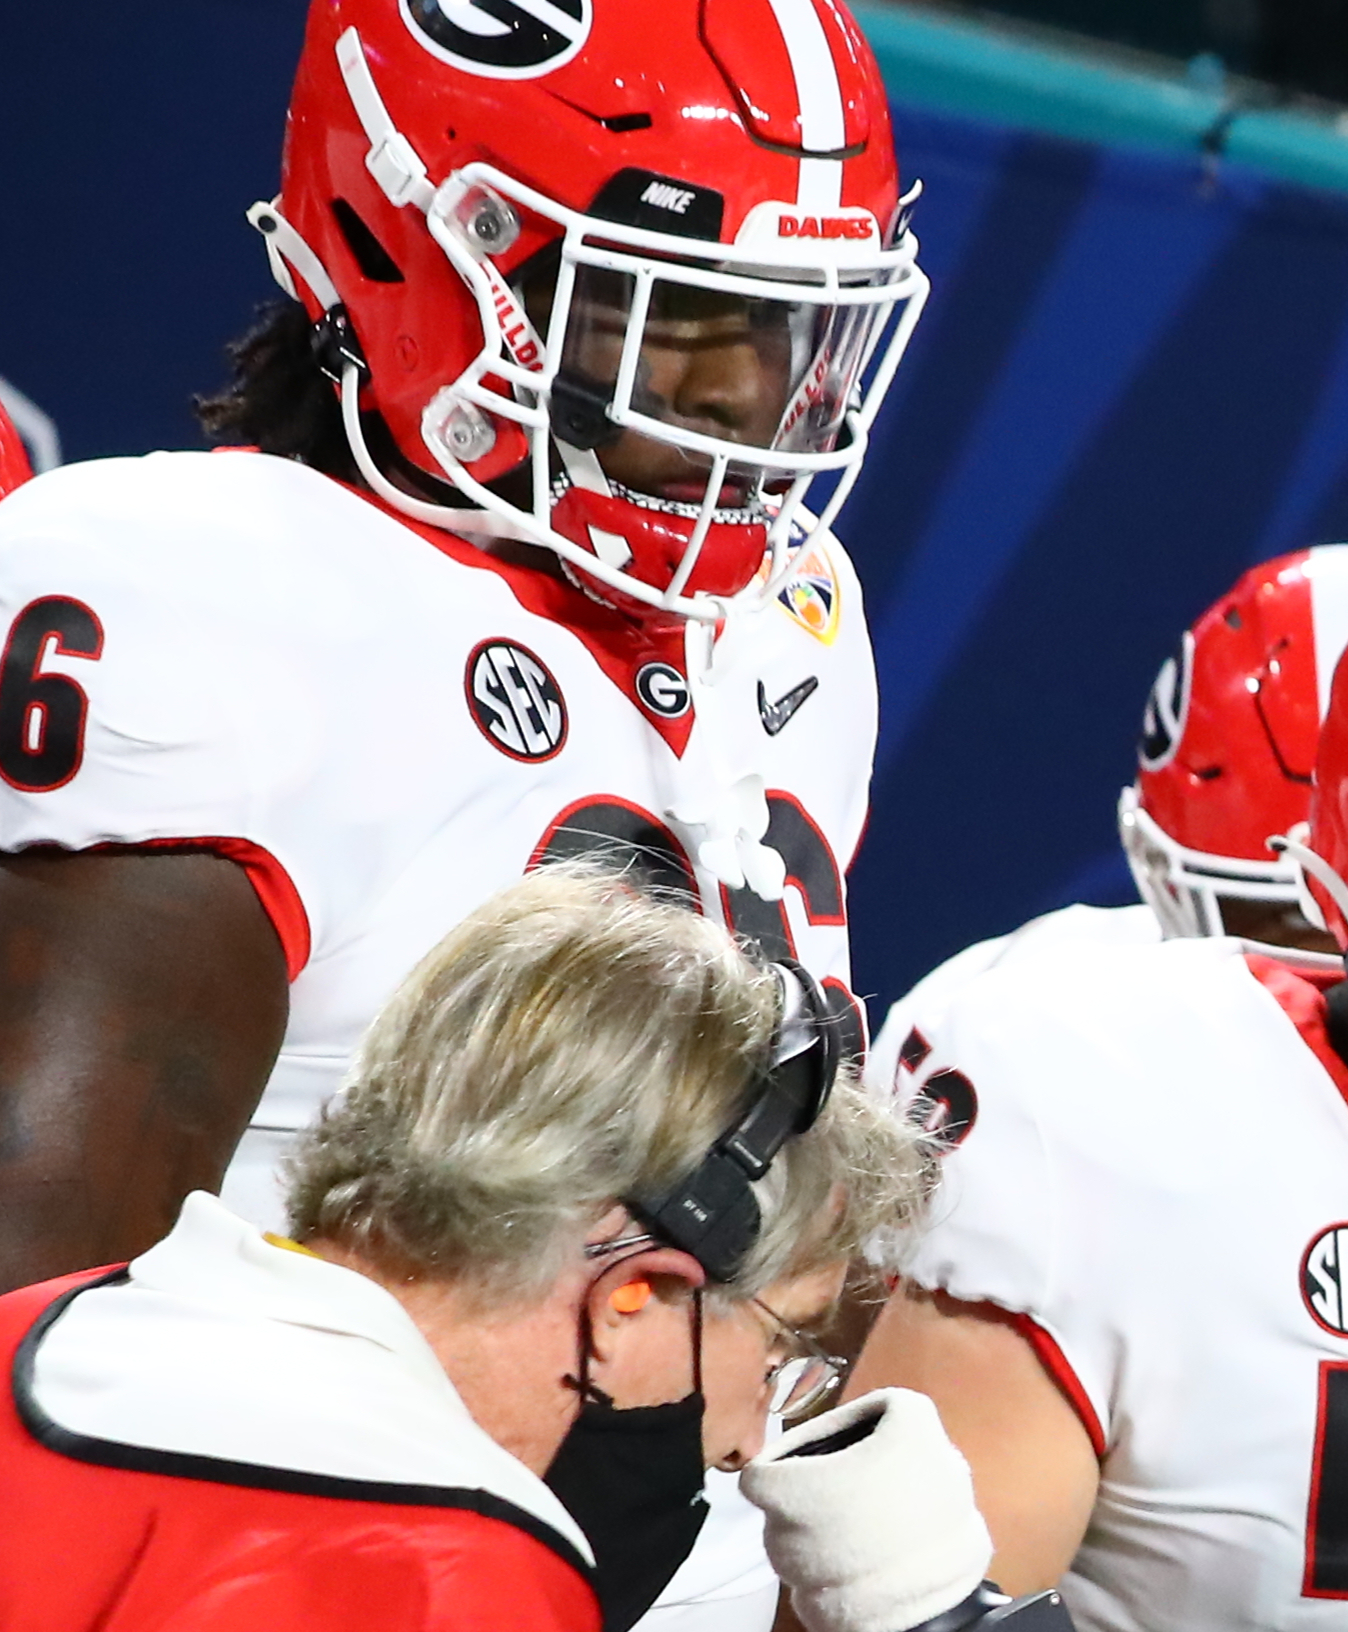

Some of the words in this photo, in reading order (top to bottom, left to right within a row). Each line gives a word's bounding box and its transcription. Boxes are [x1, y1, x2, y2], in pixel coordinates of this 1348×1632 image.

[641, 181, 695, 214] NIKE
[0, 594, 104, 793] 6
[472, 645, 563, 756] SEC
[637, 663, 690, 718] G
